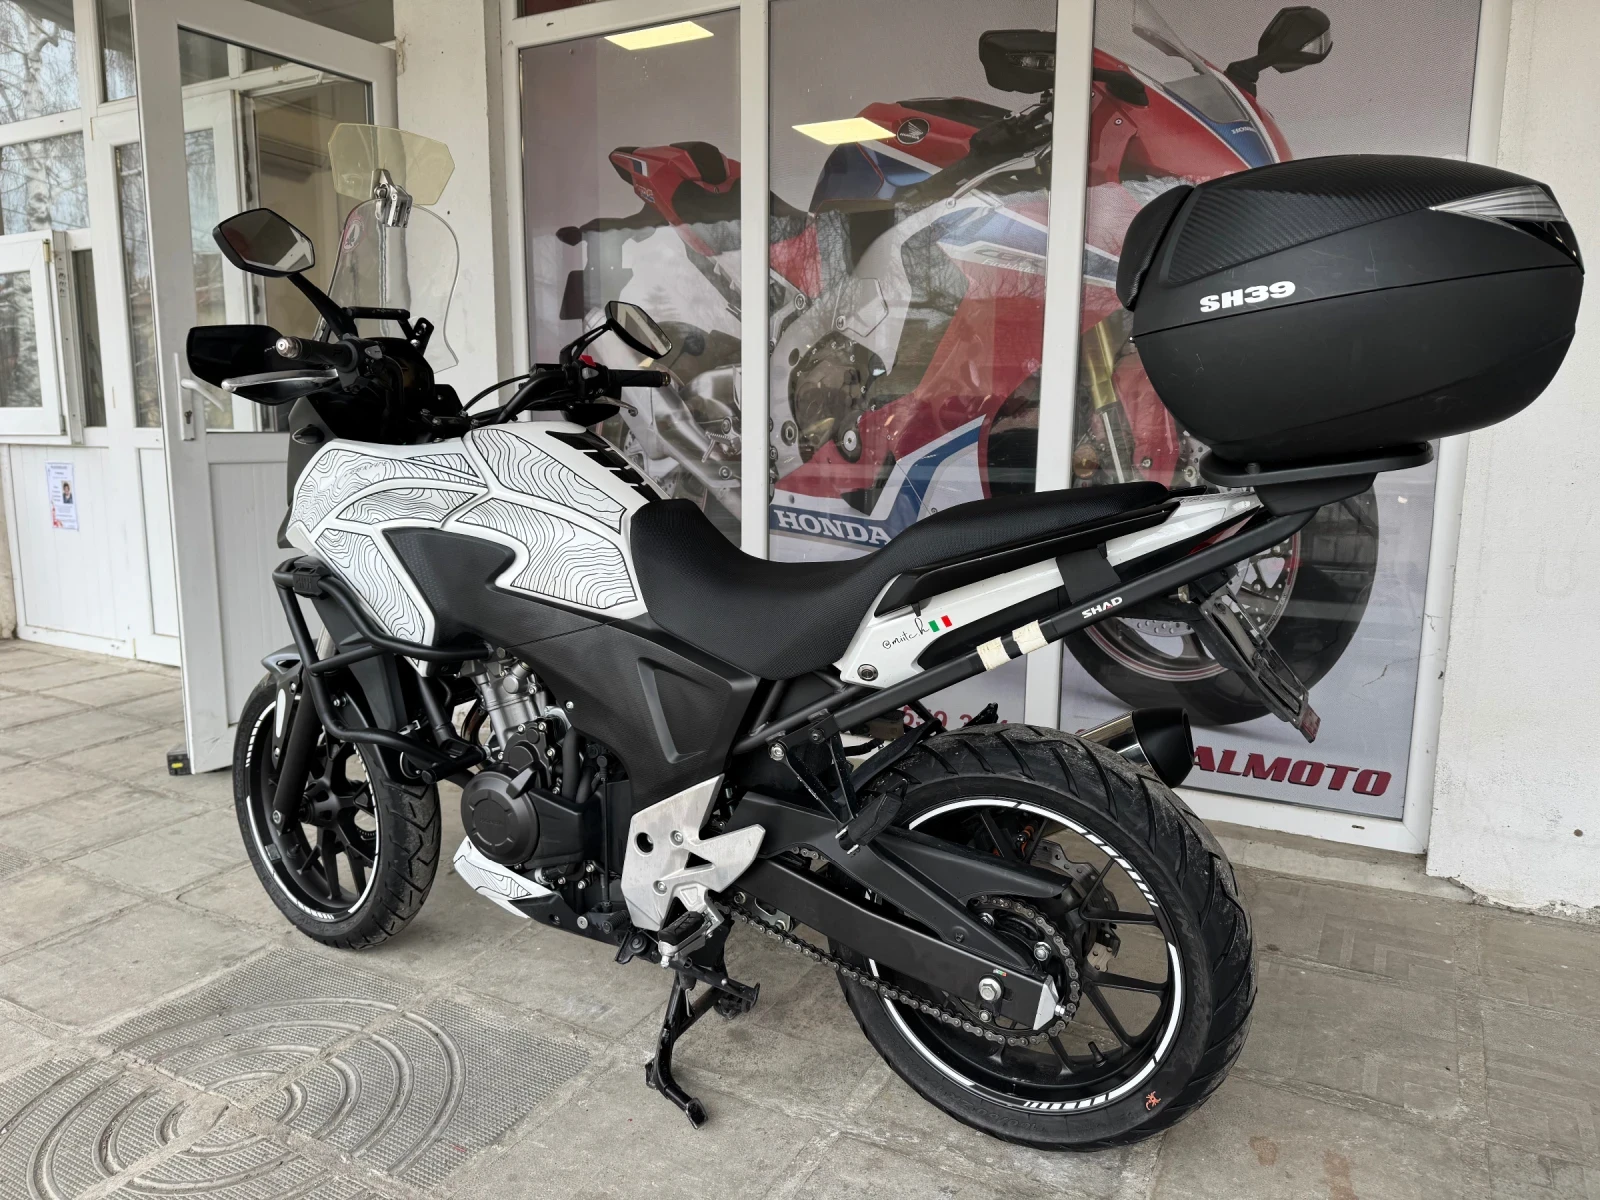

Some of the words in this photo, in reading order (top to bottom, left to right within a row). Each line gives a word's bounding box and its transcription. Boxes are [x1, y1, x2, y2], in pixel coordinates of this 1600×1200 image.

[1199, 280, 1296, 313] SH39
[773, 509, 893, 546] HONDA
[1081, 596, 1123, 619] SHAD
